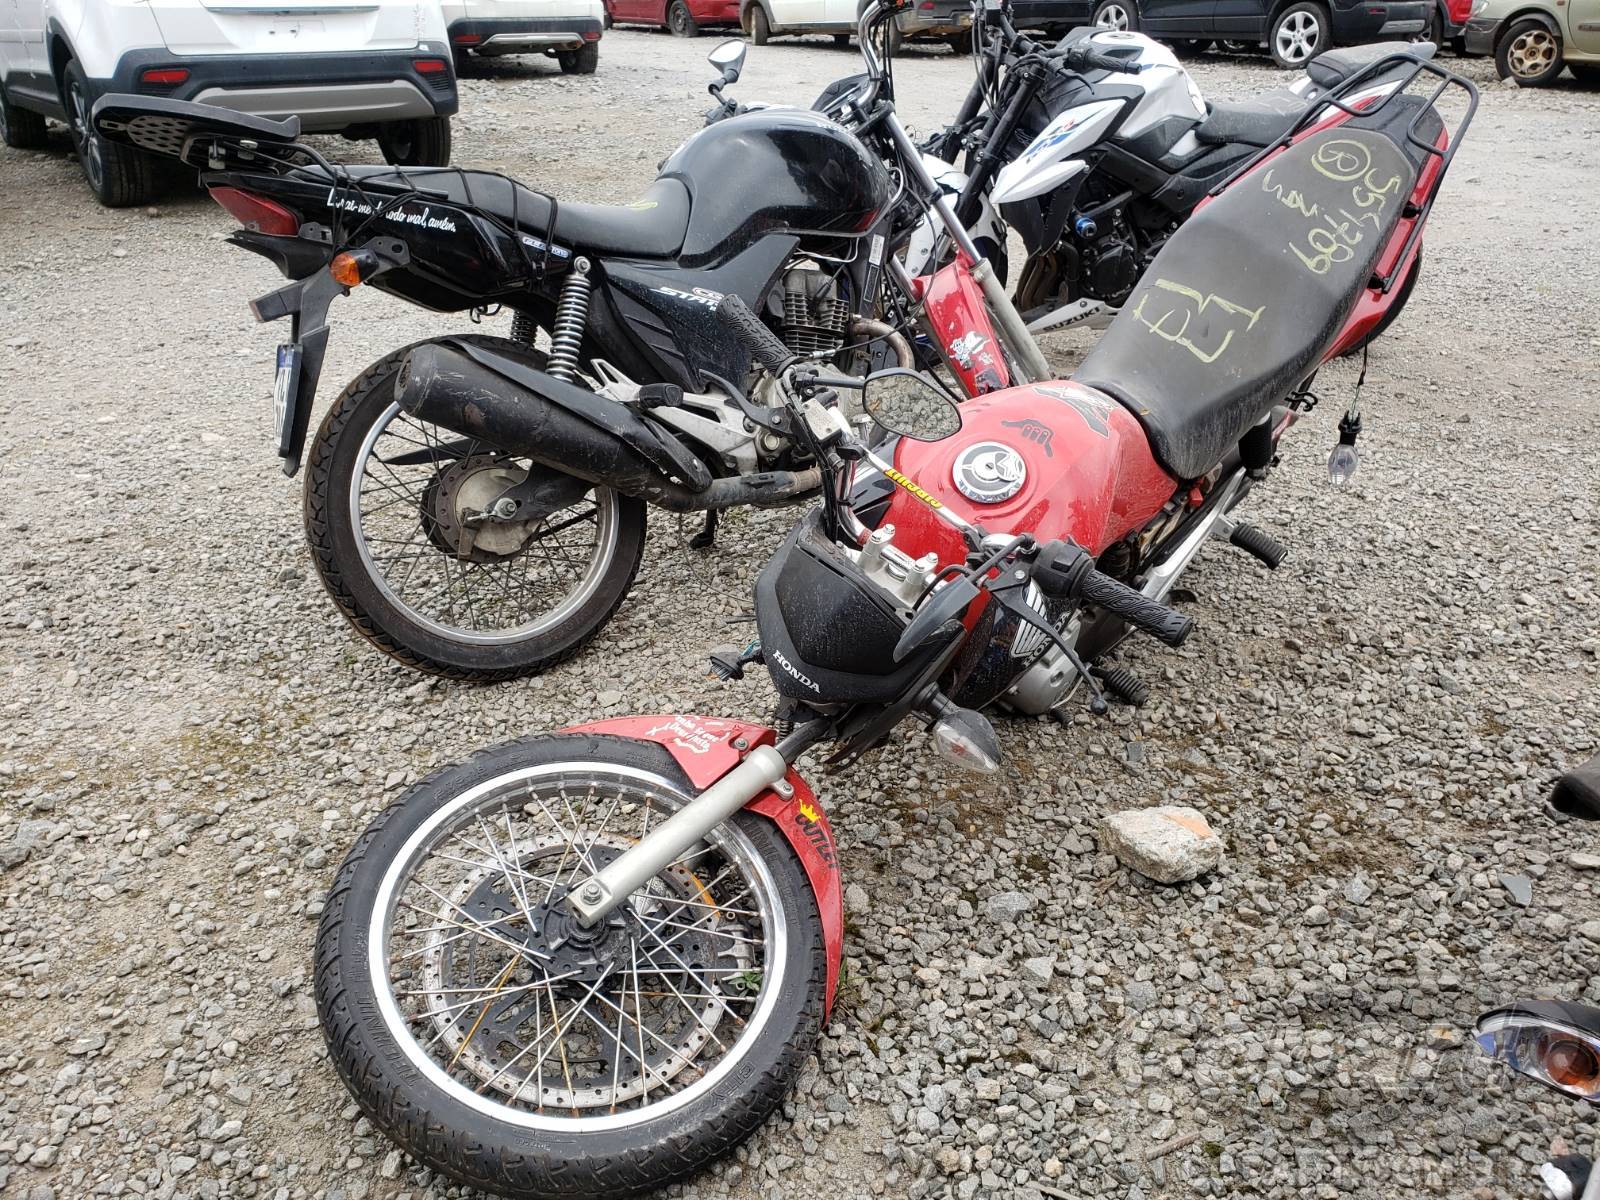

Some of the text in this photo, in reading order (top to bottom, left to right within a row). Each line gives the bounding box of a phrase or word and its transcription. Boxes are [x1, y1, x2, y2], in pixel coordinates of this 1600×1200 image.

[1043, 306, 1100, 331] SUZUKI
[884, 469, 943, 509] CIRCUIT
[772, 650, 821, 694] HONDA
[709, 1060, 756, 1105] CITY
